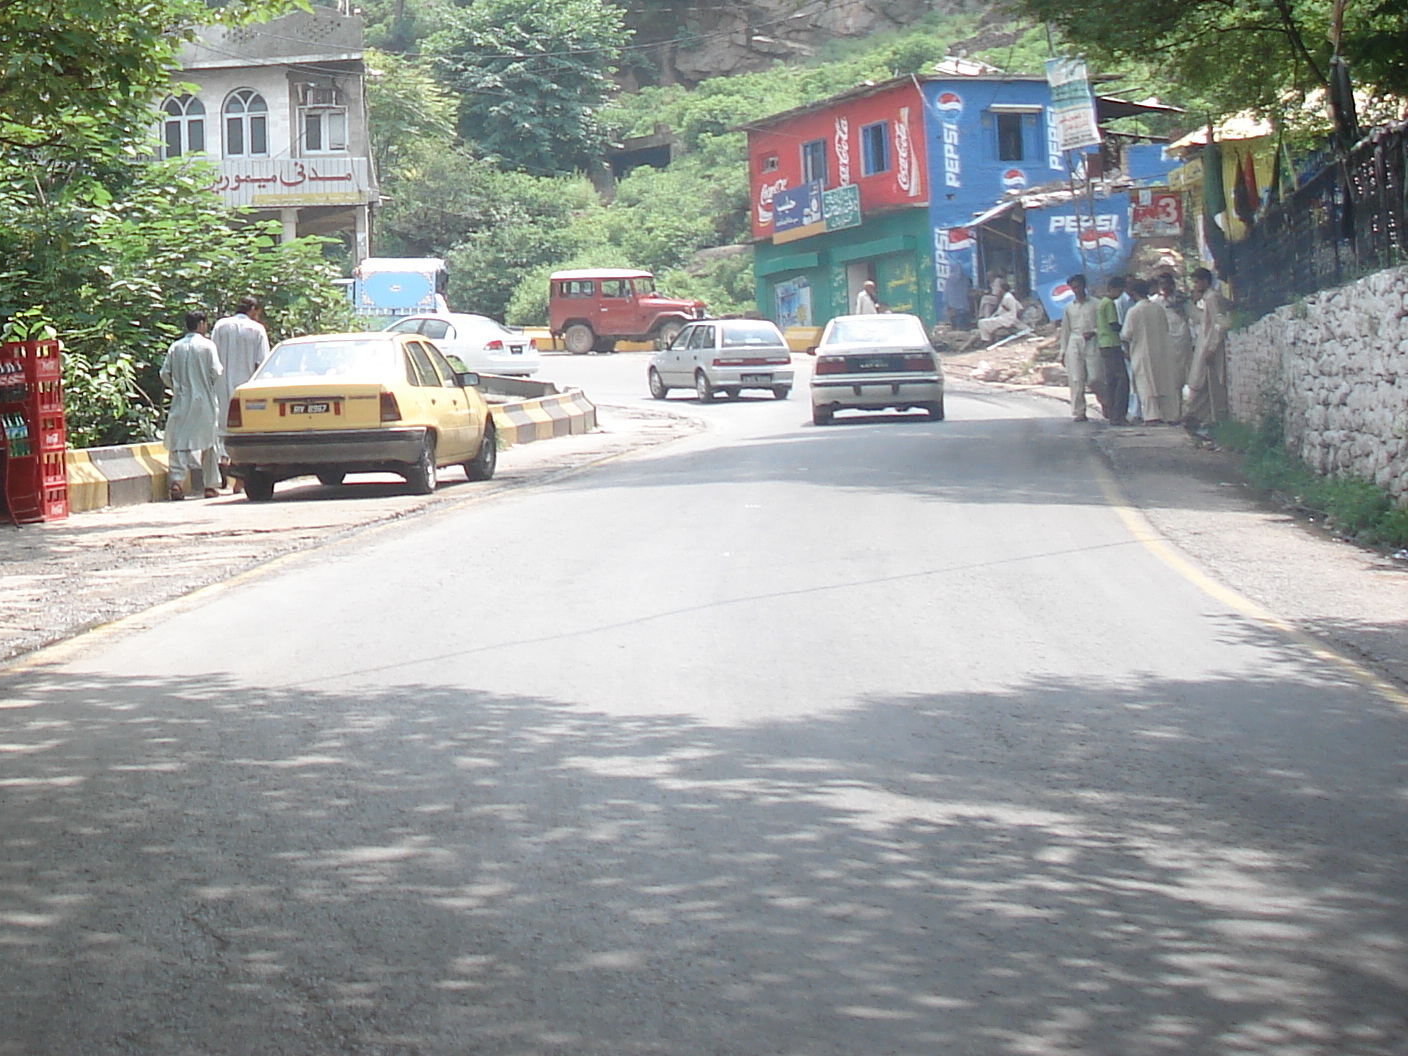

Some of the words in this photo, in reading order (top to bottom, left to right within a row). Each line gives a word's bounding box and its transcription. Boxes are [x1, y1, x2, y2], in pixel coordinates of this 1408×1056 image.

[280, 161, 352, 187] مدنی
[943, 122, 961, 188] PEPSI
[1048, 214, 1119, 232] PEPSI
[934, 228, 951, 292] PEPSI
